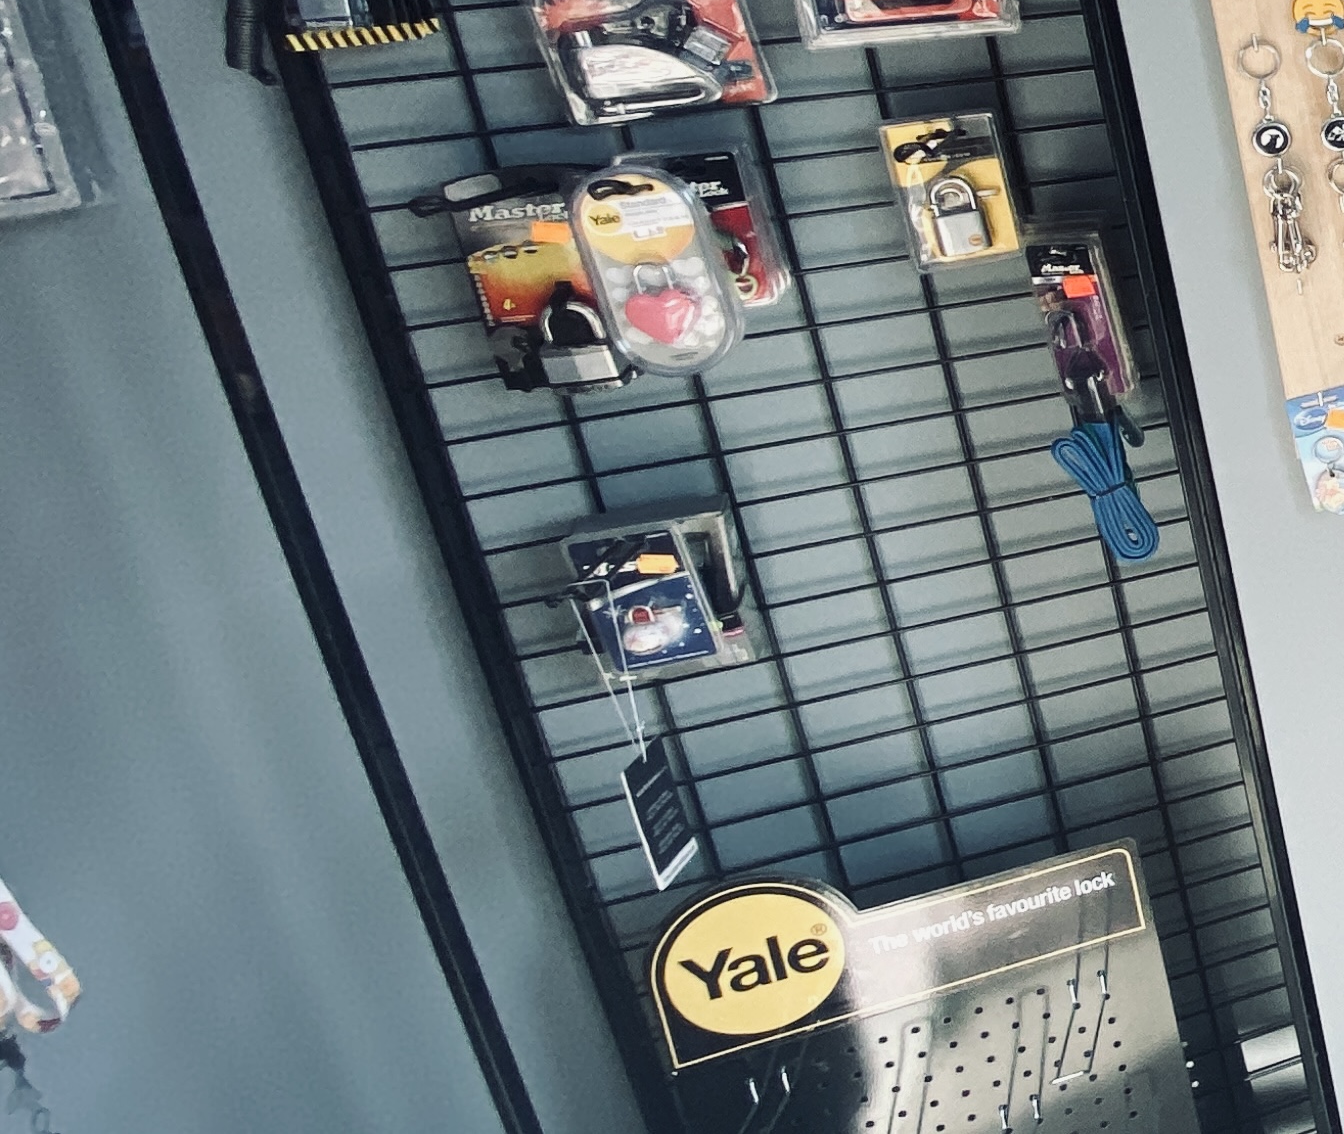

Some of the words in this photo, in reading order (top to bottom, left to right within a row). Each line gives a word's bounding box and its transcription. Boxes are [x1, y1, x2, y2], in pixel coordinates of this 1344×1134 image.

[469, 202, 565, 222] Master
[589, 211, 621, 227] Yale
[868, 933, 909, 954] The
[912, 910, 984, 945] world's
[986, 884, 1072, 922] favourite
[1074, 871, 1116, 897] lock
[678, 934, 831, 1001] Yale
